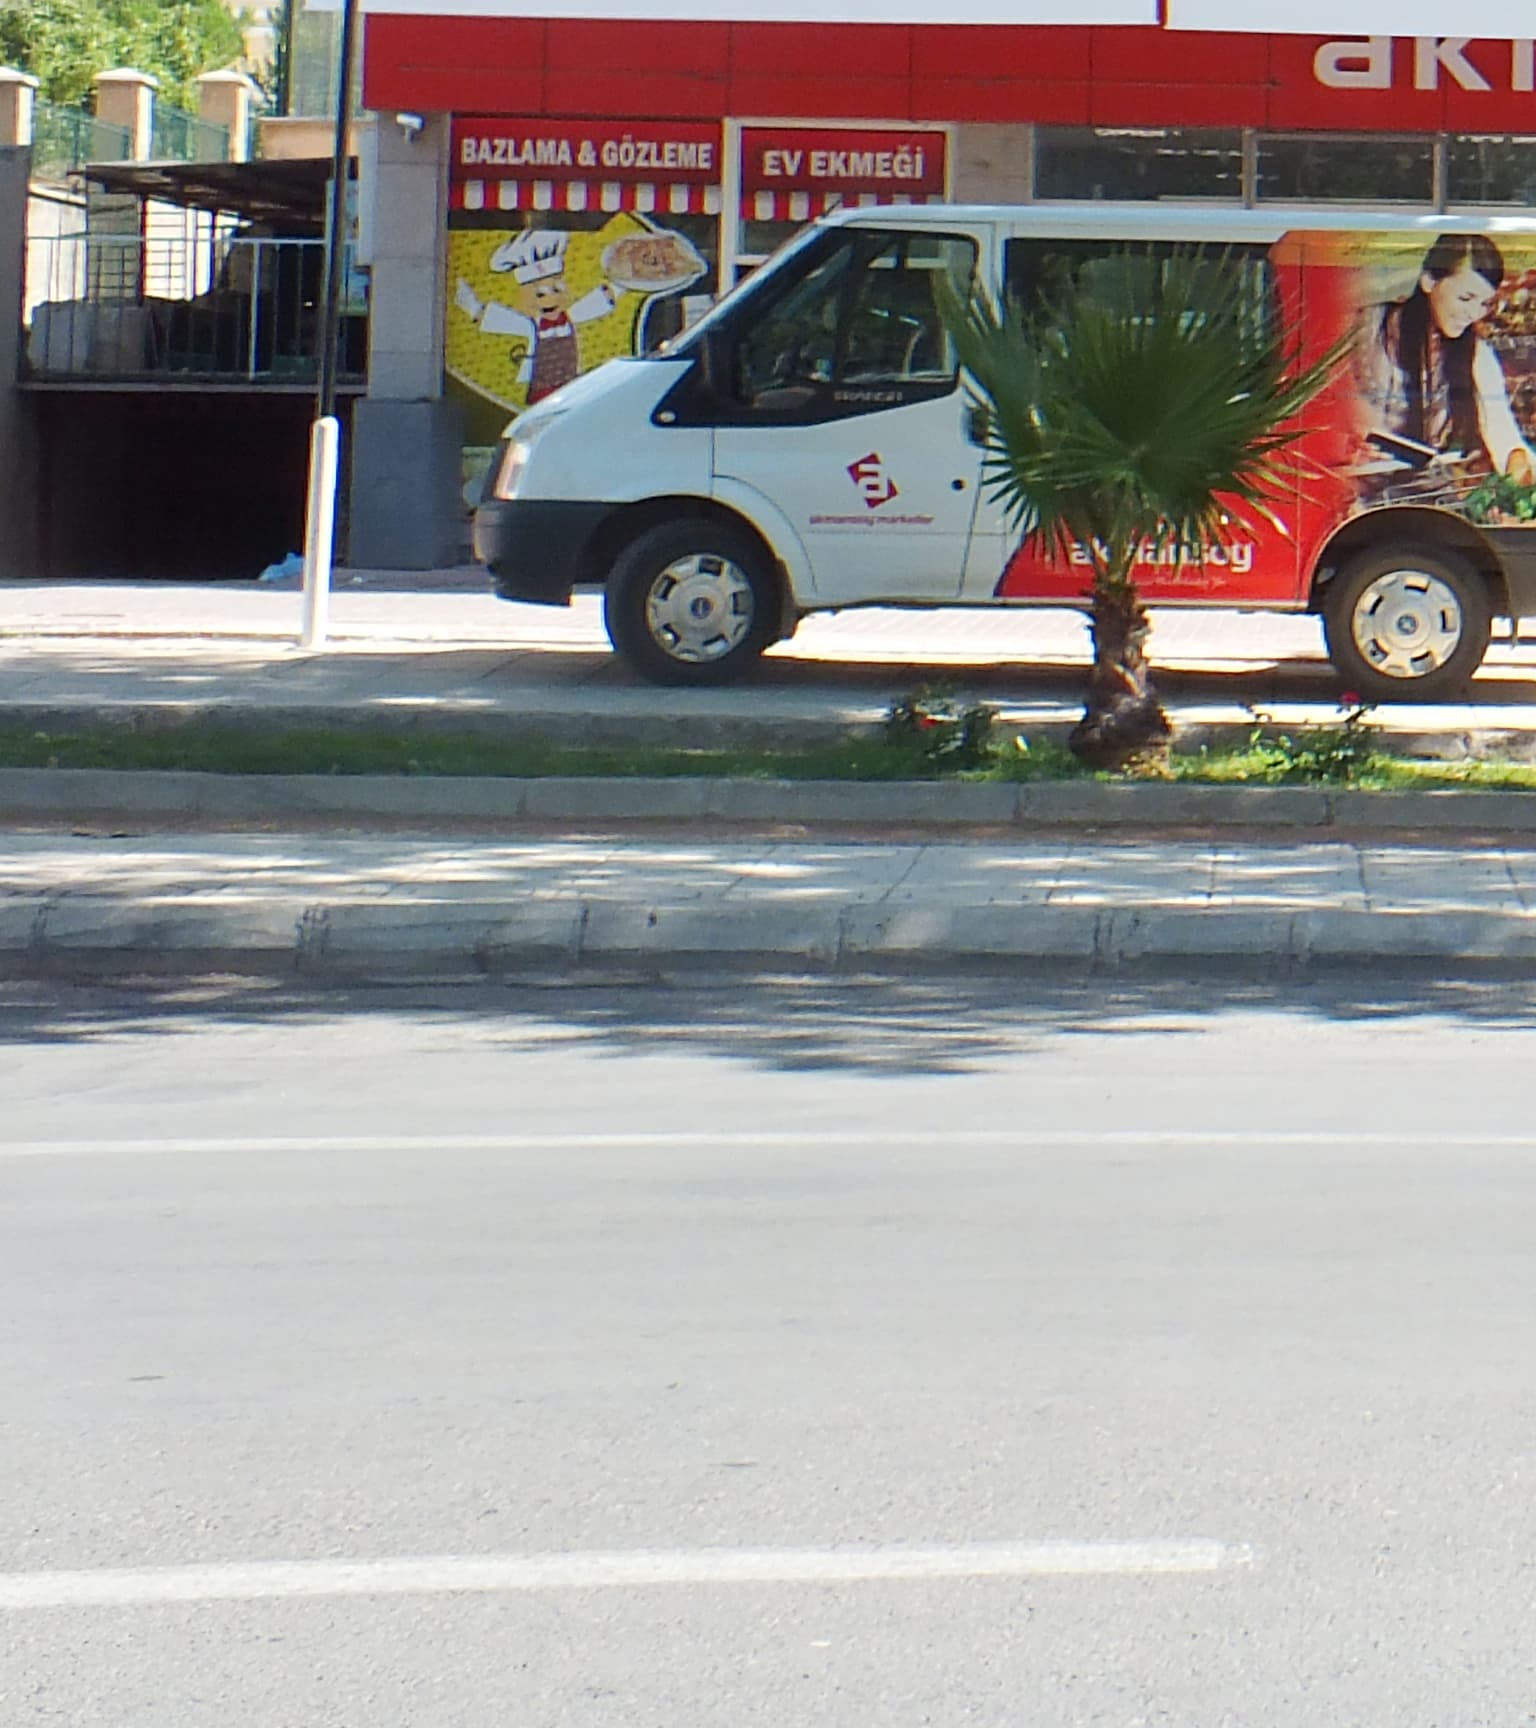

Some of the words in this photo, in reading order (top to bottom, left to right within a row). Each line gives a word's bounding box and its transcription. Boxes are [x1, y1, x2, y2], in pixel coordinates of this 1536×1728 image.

[461, 138, 573, 166] BAZLAMA
[577, 142, 596, 166] &
[602, 135, 712, 169] GÖZLEME
[763, 150, 801, 176] EV
[810, 145, 924, 179] EKMEĞİ
